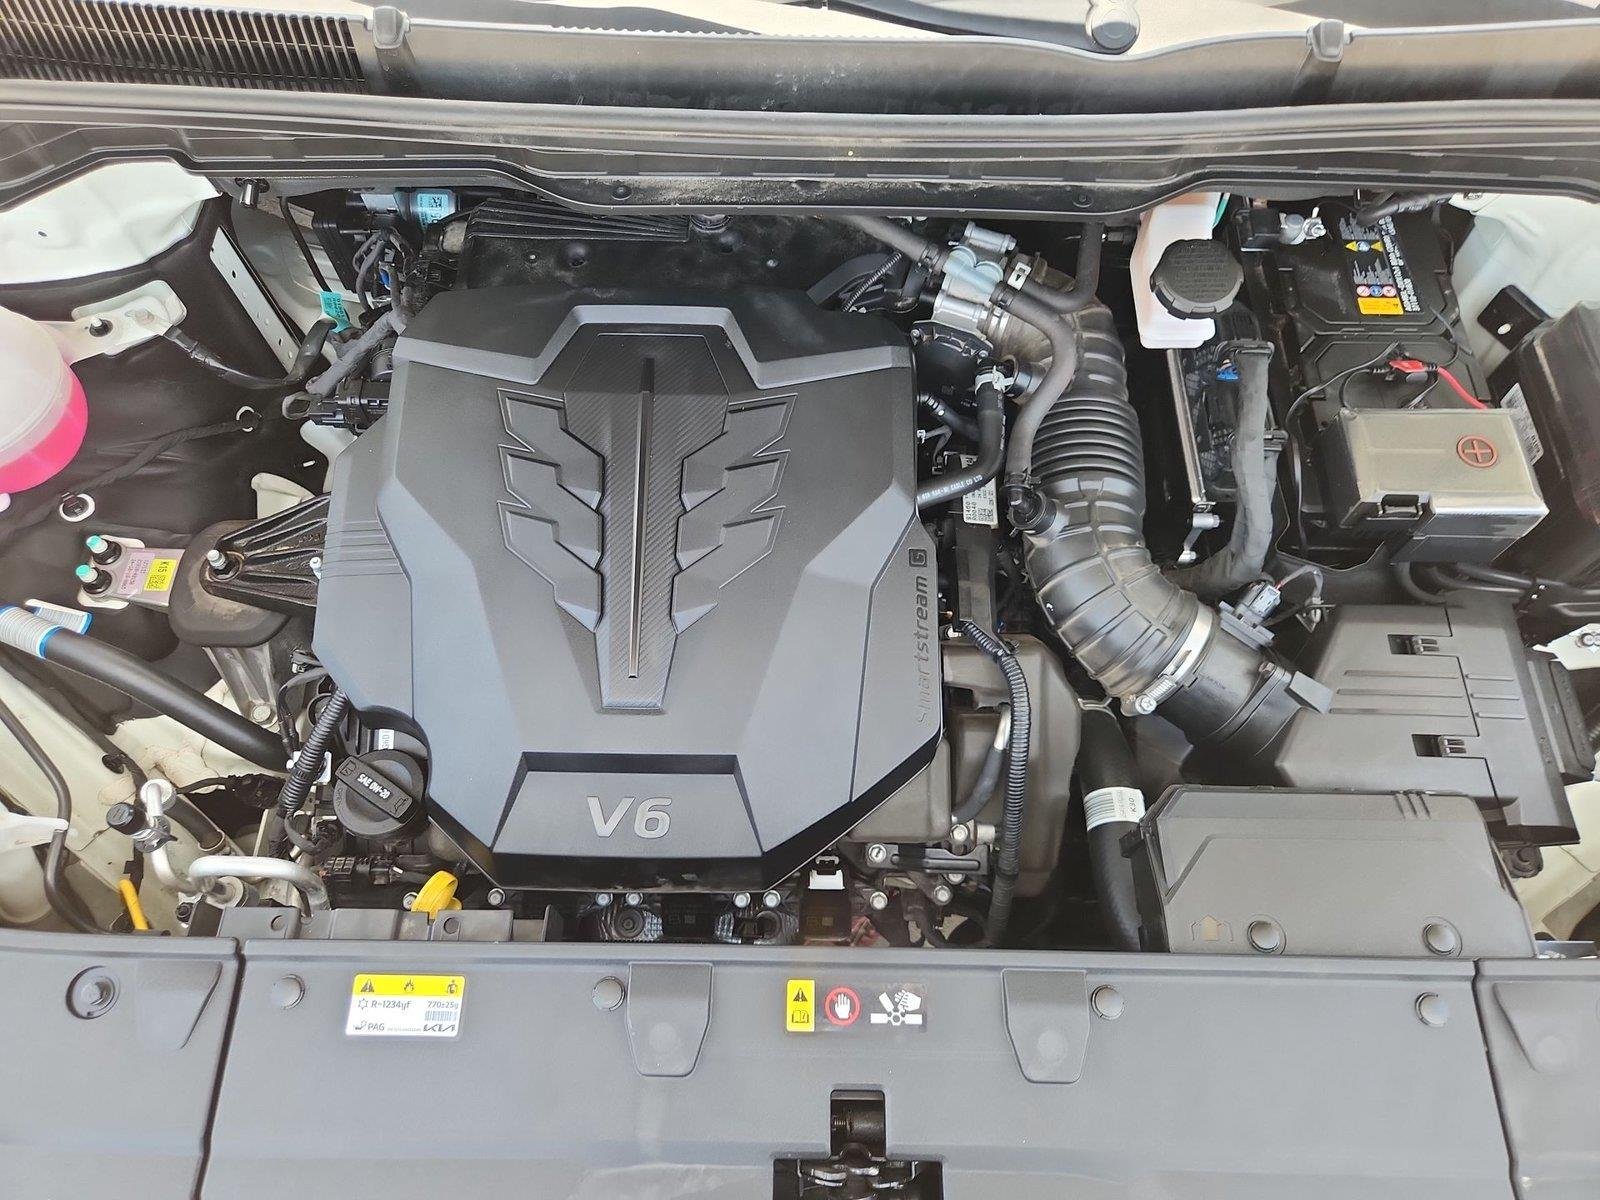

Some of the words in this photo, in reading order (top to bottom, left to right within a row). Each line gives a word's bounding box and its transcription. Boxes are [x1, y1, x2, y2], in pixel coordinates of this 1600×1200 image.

[158, 561, 170, 573] K15
[357, 773, 371, 787] SAE
[369, 780, 391, 799] 0W-20
[587, 796, 672, 839] V6
[371, 1000, 411, 1010] R-1234yf
[367, 1023, 385, 1031] PAG
